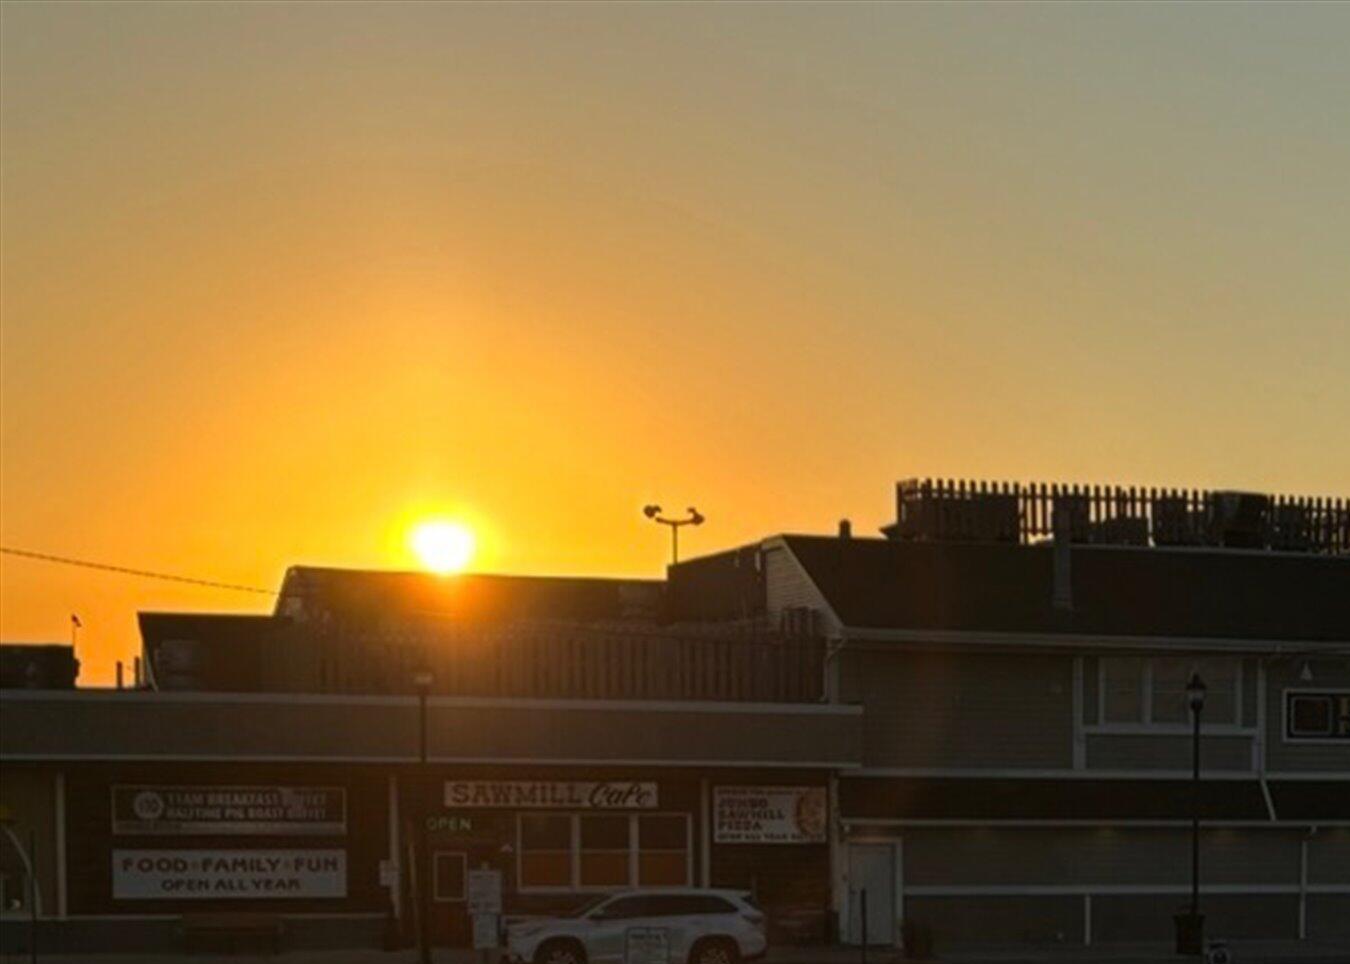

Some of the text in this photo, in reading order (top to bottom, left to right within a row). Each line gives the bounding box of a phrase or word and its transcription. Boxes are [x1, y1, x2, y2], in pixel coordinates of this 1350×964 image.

[452, 784, 583, 804] SAWMILL
[426, 817, 473, 832] OPEN
[122, 858, 338, 873] FOOD FAMILY FUN
[161, 879, 300, 891] OPEN ALL YEAR
